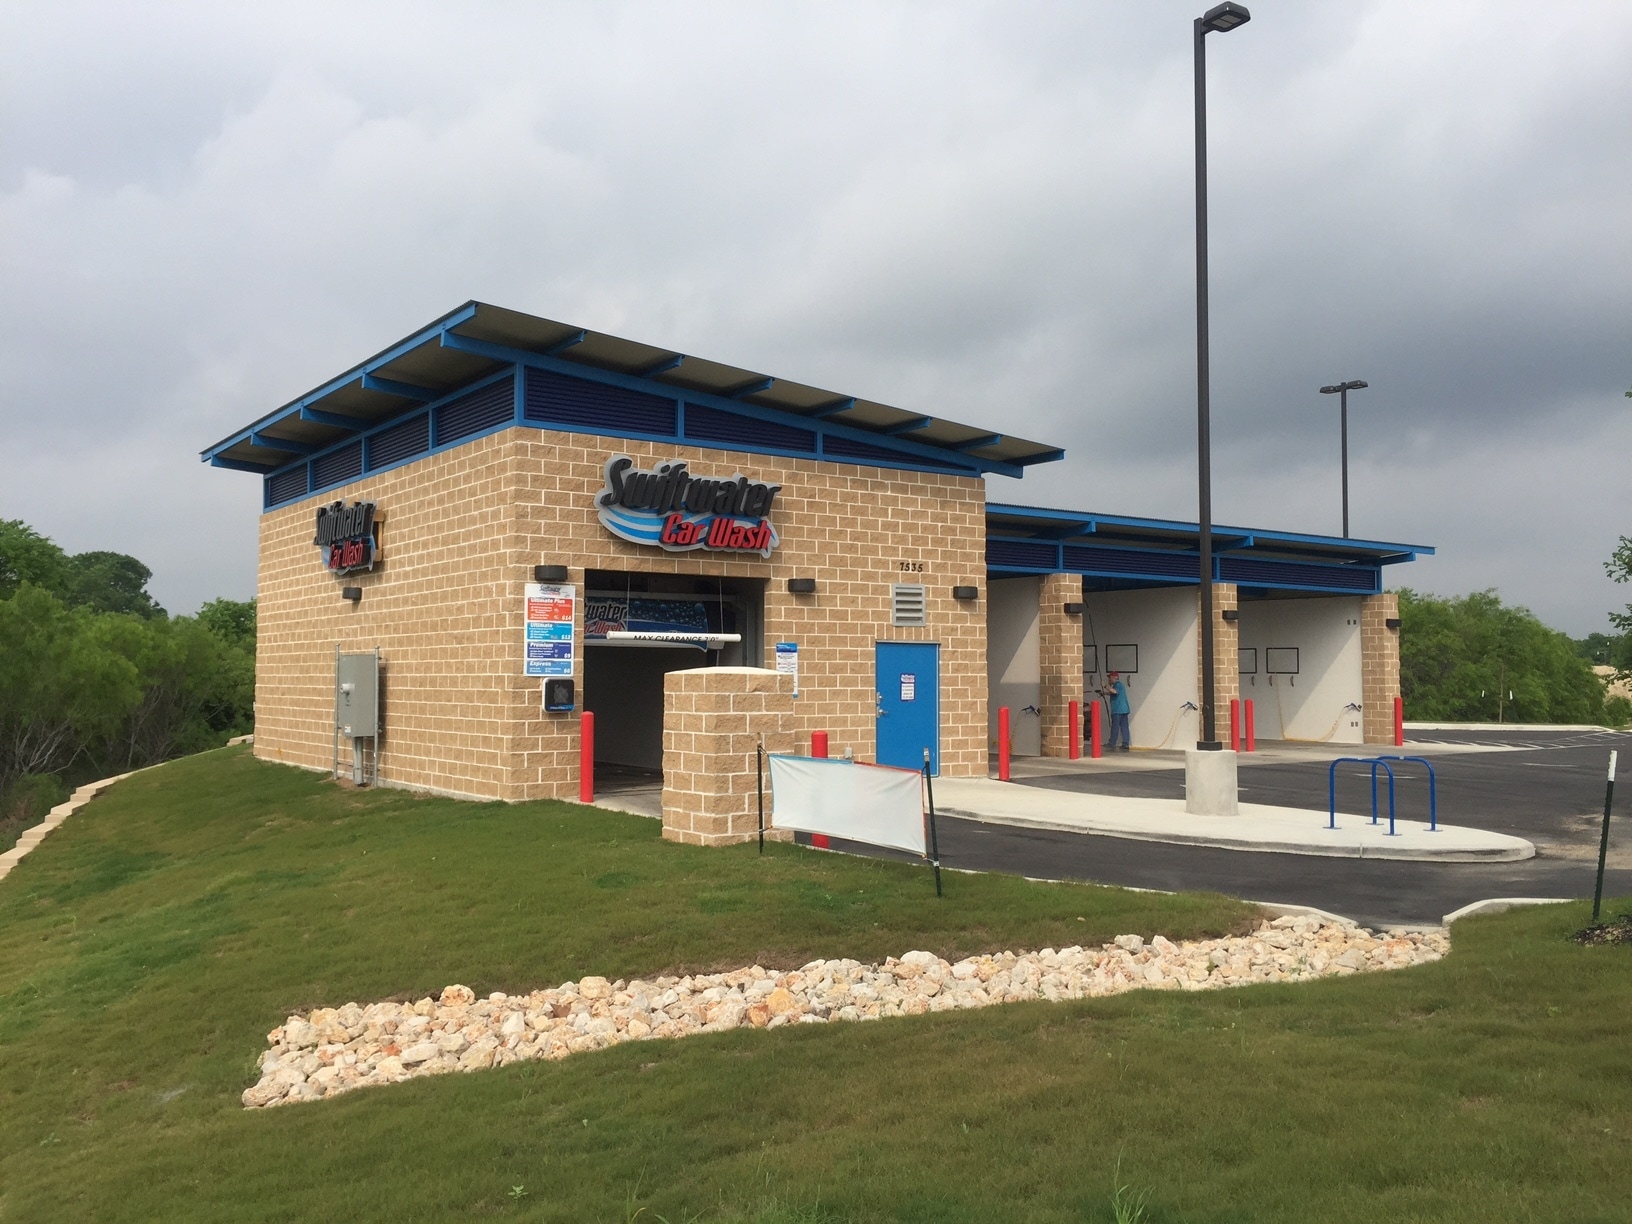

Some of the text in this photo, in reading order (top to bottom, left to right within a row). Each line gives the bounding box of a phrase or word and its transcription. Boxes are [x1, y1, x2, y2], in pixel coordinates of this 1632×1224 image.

[600, 458, 781, 516] Swiftwater
[660, 513, 772, 549] Car Wash
[900, 562, 923, 573] 7535
